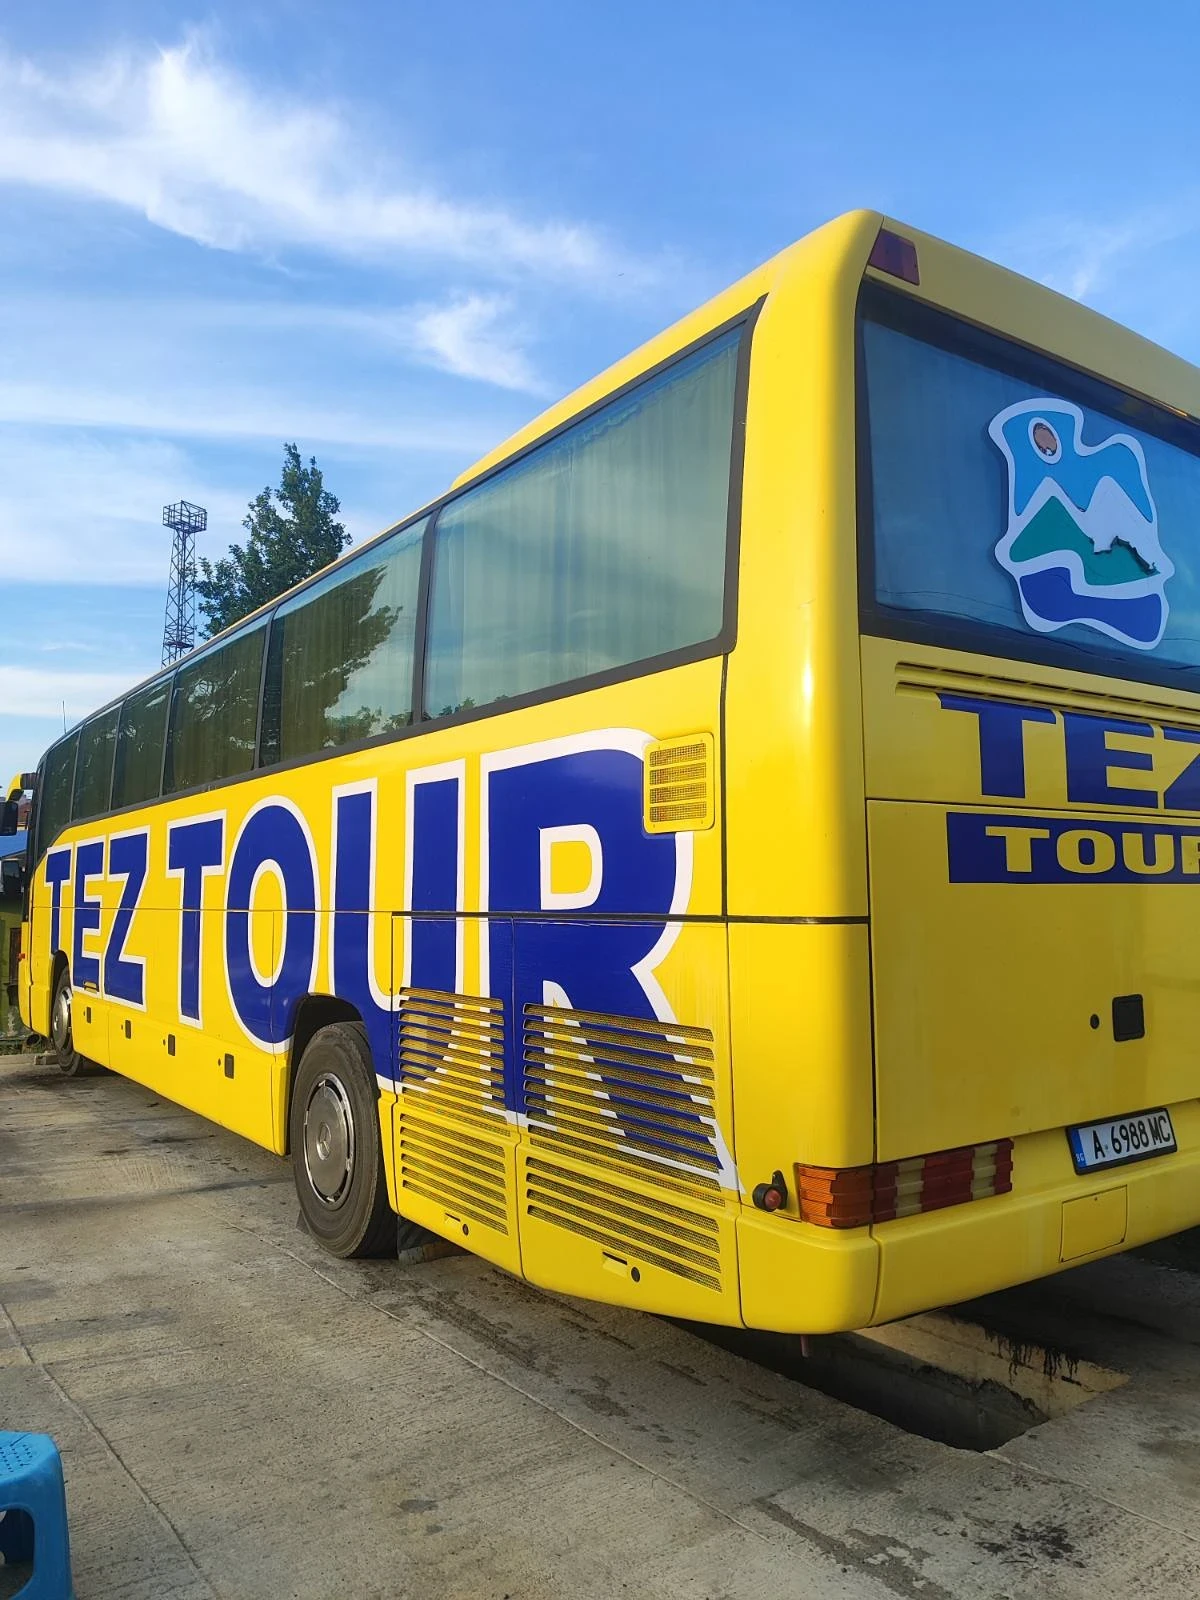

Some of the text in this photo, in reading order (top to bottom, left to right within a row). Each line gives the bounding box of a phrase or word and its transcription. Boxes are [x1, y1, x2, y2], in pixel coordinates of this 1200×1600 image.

[45, 727, 745, 1194] TEZ TOUR
[1110, 1120, 1150, 1154] 6988
[1147, 1115, 1171, 1145] MC
